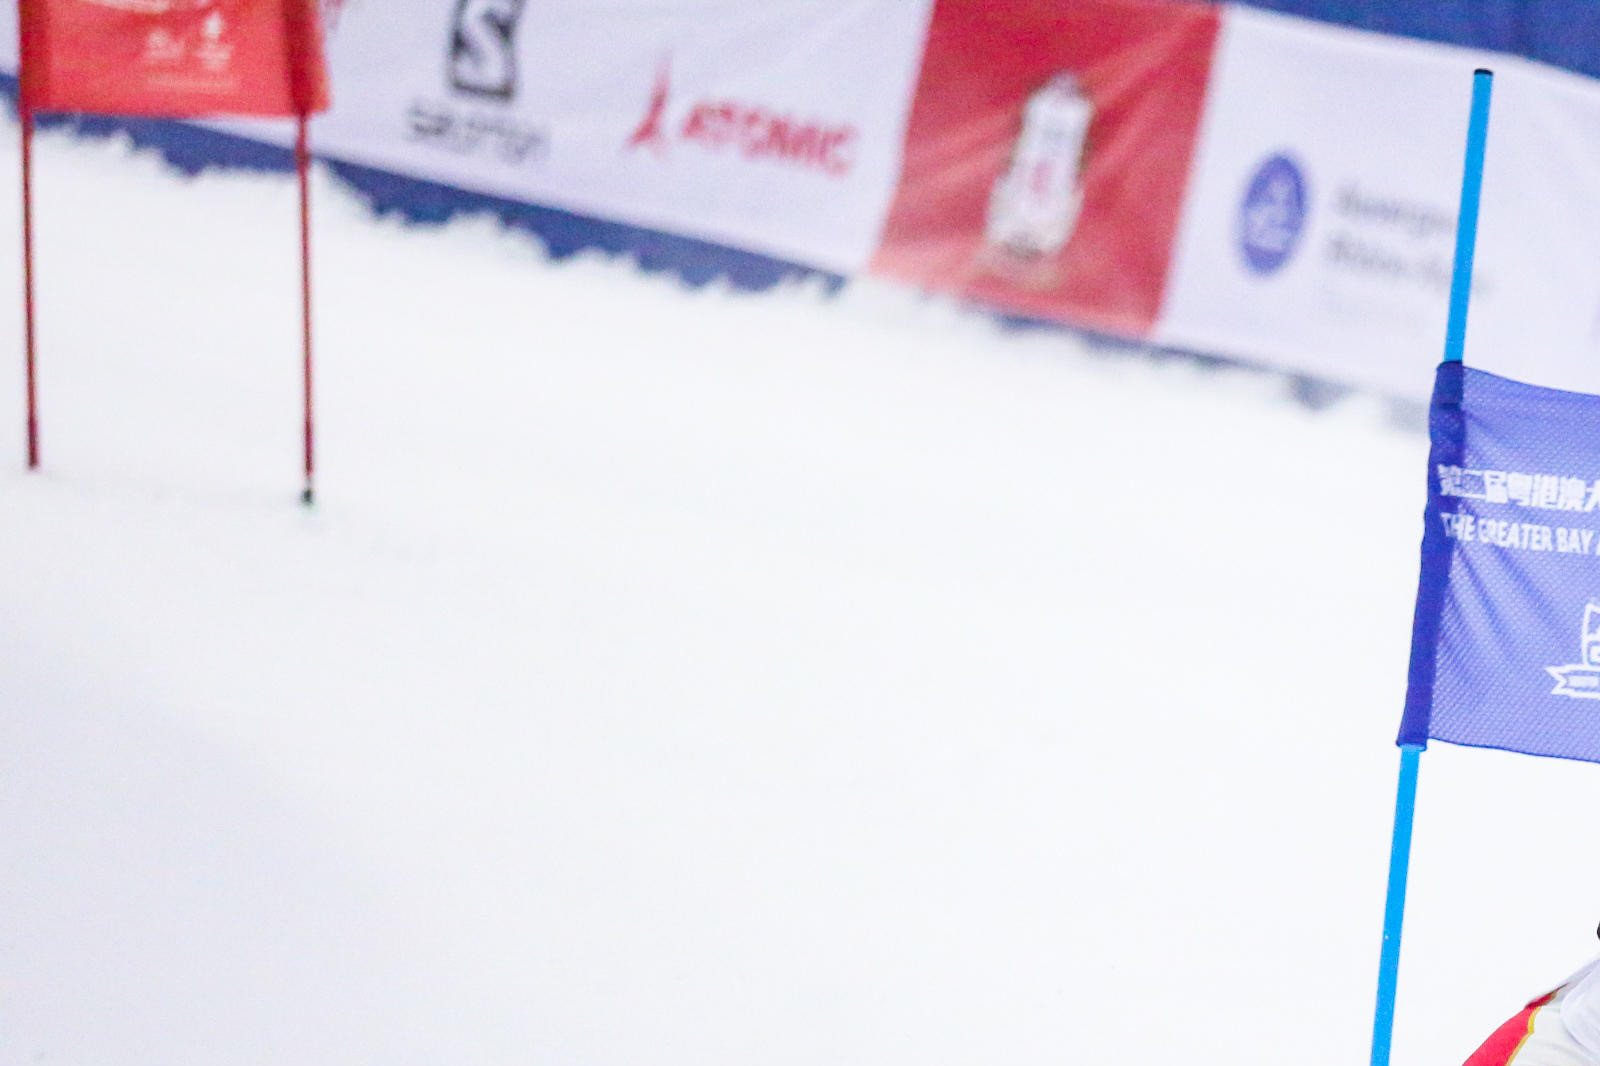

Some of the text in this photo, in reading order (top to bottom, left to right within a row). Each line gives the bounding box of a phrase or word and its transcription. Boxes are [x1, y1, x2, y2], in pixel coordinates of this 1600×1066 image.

[682, 98, 857, 180] ATOMIC
[1440, 512, 1476, 541] THE
[1477, 518, 1553, 551] GREATER
[1556, 526, 1594, 554] BAY
